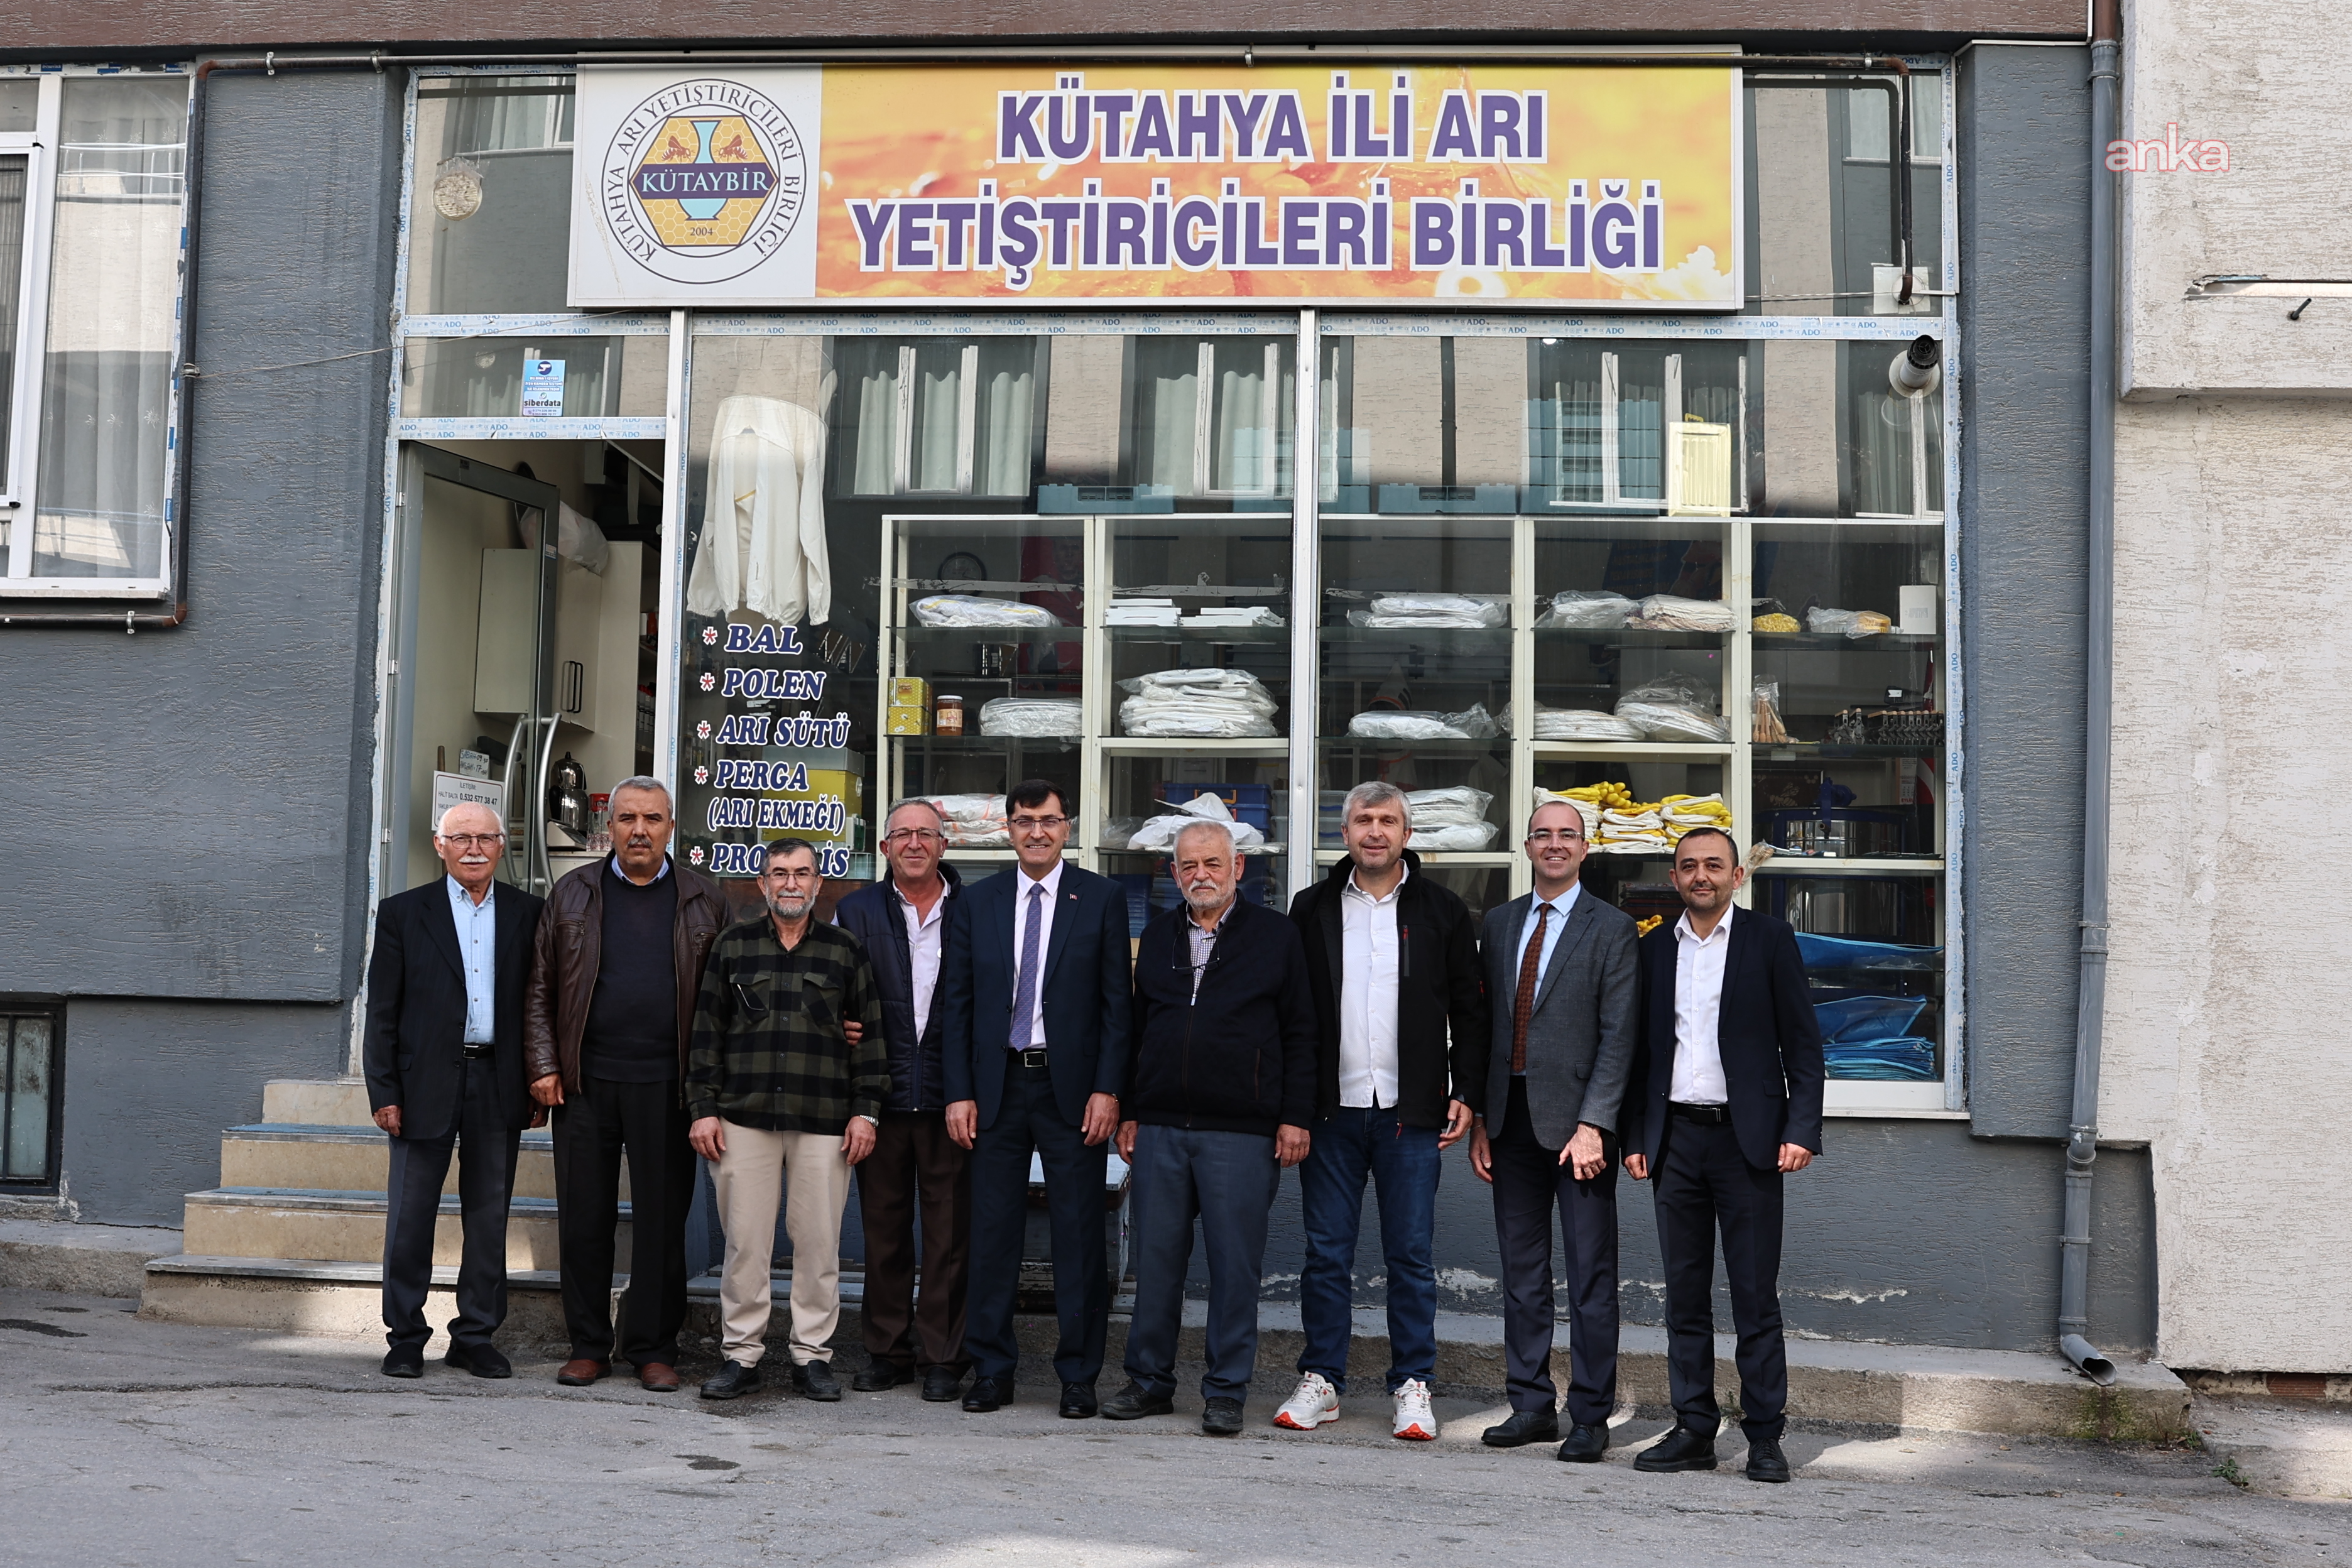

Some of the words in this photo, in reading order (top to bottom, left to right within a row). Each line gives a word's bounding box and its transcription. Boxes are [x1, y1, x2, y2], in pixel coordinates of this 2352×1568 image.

[642, 82, 802, 163] YETİŞTİRİCİLERİ
[1001, 74, 1310, 161] KÜTAHYA
[1329, 74, 1412, 160] İLİ
[1430, 92, 1545, 160] ARI
[617, 117, 648, 157] ARI
[641, 166, 770, 193] KÜTAYBİR
[607, 165, 658, 263] KÜTAHYA
[689, 227, 714, 237] 2004
[751, 174, 803, 257] BİRLİĞİ
[849, 182, 1390, 286] YETİŞTİRİCİLERİ
[1412, 181, 1661, 270] BİRLİĞİ
[524, 398, 561, 406] siberdata
[724, 623, 803, 655] BAL
[721, 668, 827, 700] POLEN
[716, 714, 771, 746] ARI
[774, 710, 851, 748] SÜTÜ
[714, 759, 810, 792] PERGA
[438, 790, 448, 798] HALİT
[459, 793, 473, 802] 0.532
[474, 795, 483, 803] 577
[707, 797, 754, 832] (ARI
[757, 793, 846, 836] EKMEĞİ)
[709, 839, 849, 877] PROİS
